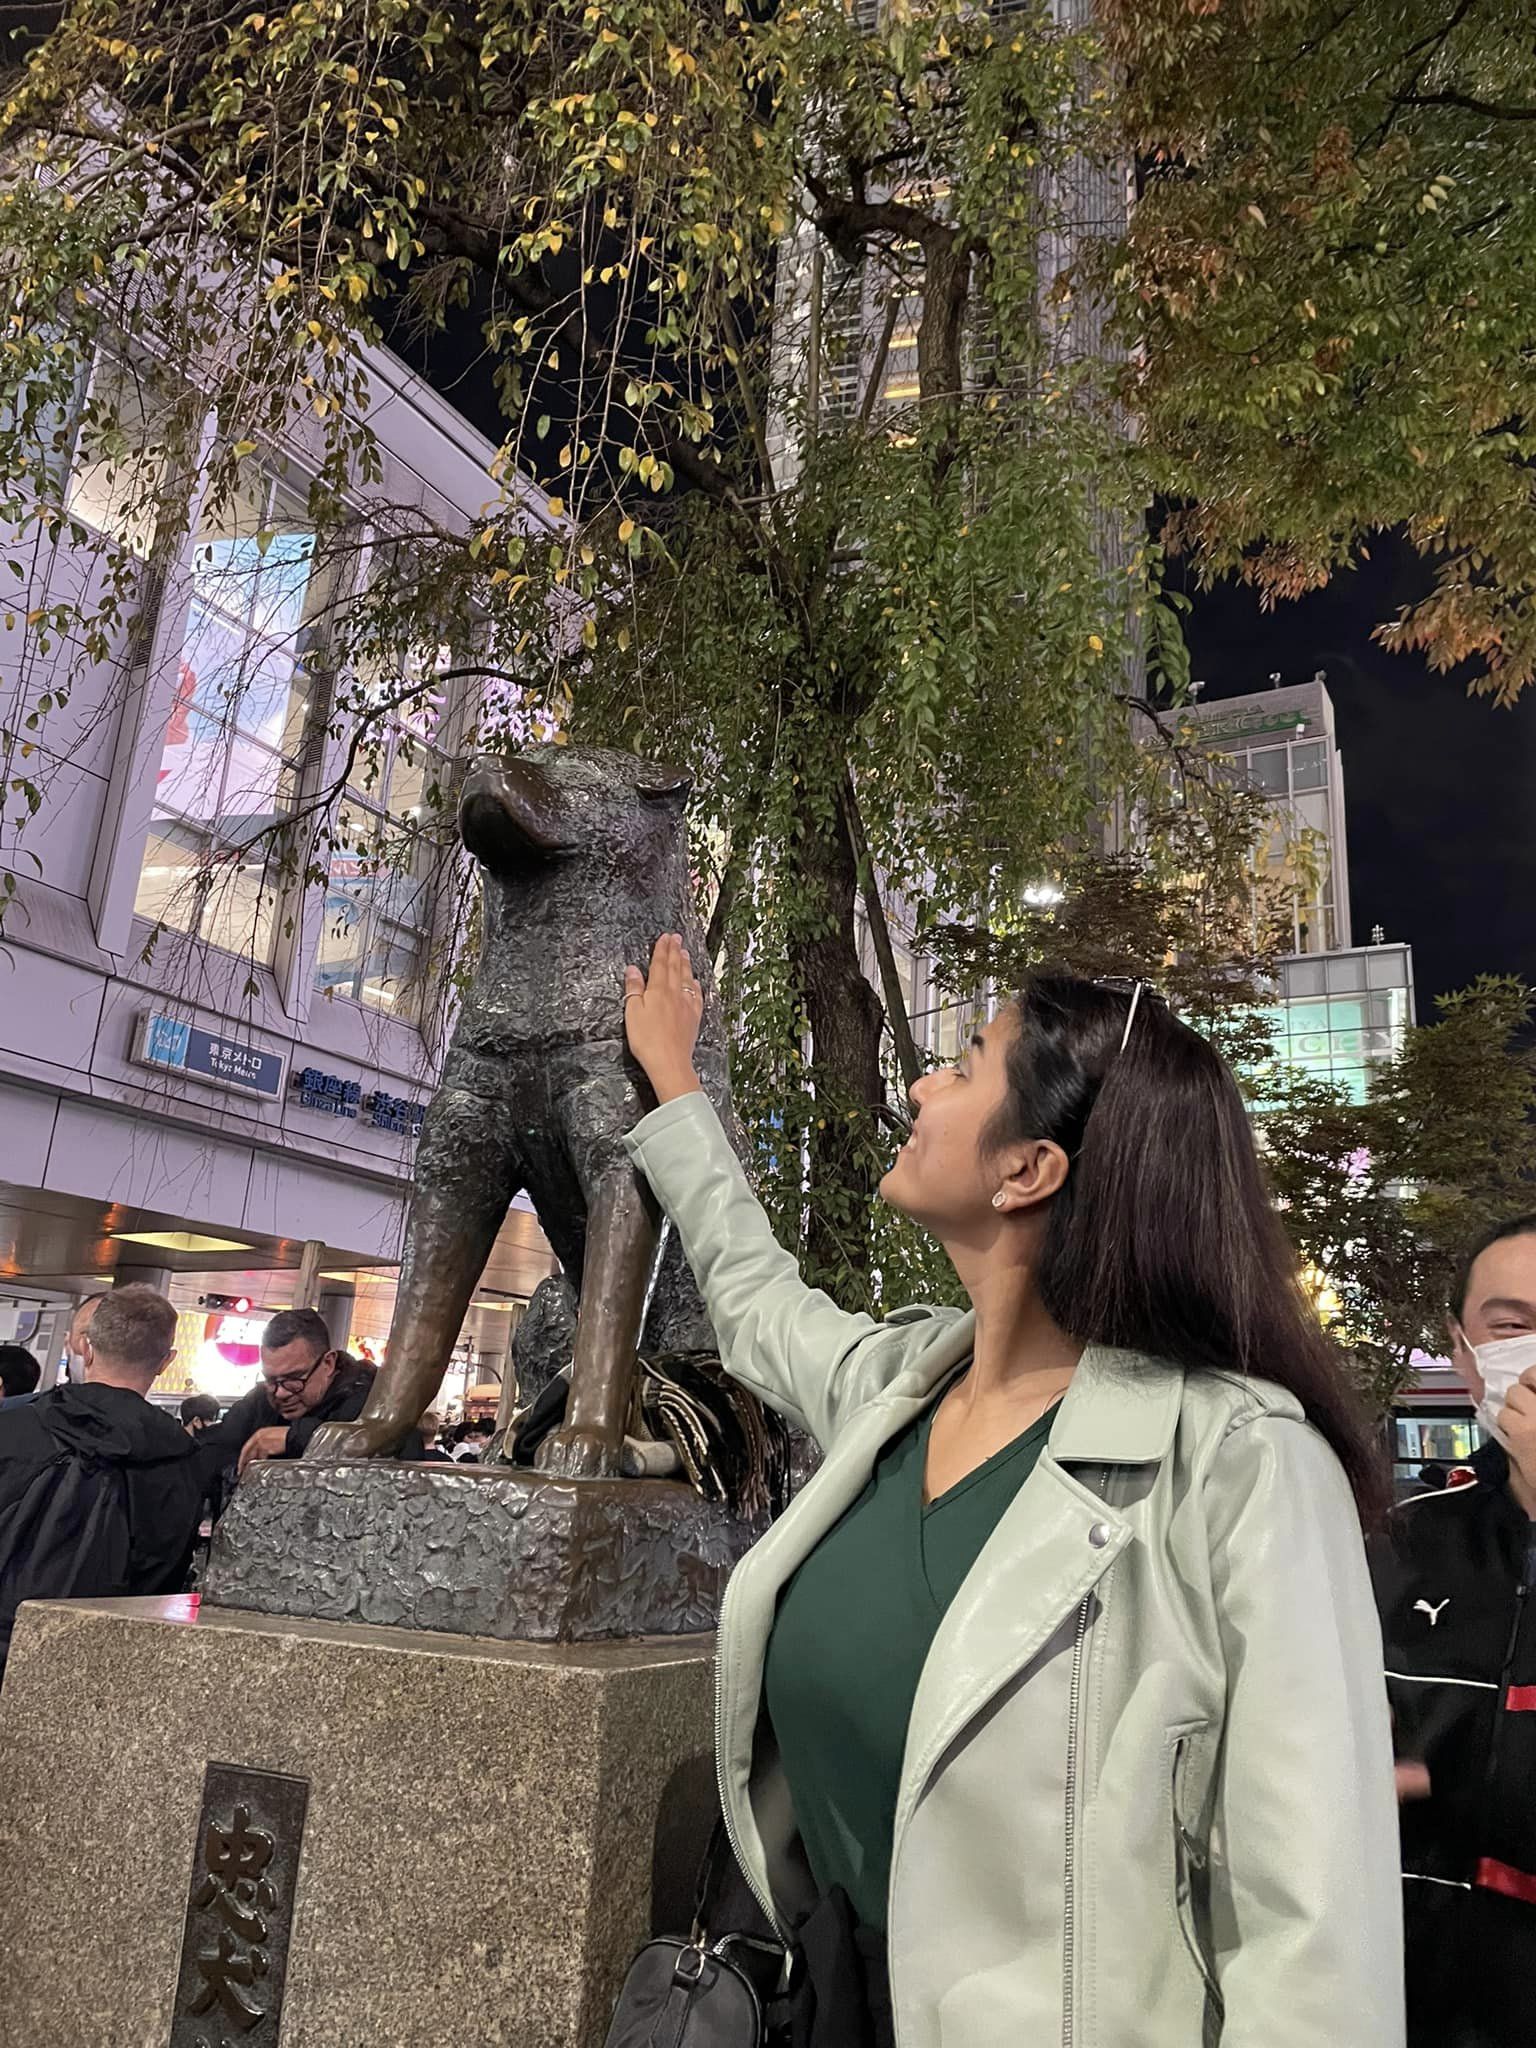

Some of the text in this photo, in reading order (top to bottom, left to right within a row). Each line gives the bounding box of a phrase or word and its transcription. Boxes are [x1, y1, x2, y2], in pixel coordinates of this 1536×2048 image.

[208, 1042, 262, 1070] 東京メトロ
[302, 1067, 361, 1105] 銀座線
[185, 1801, 278, 2048] 忠犬
